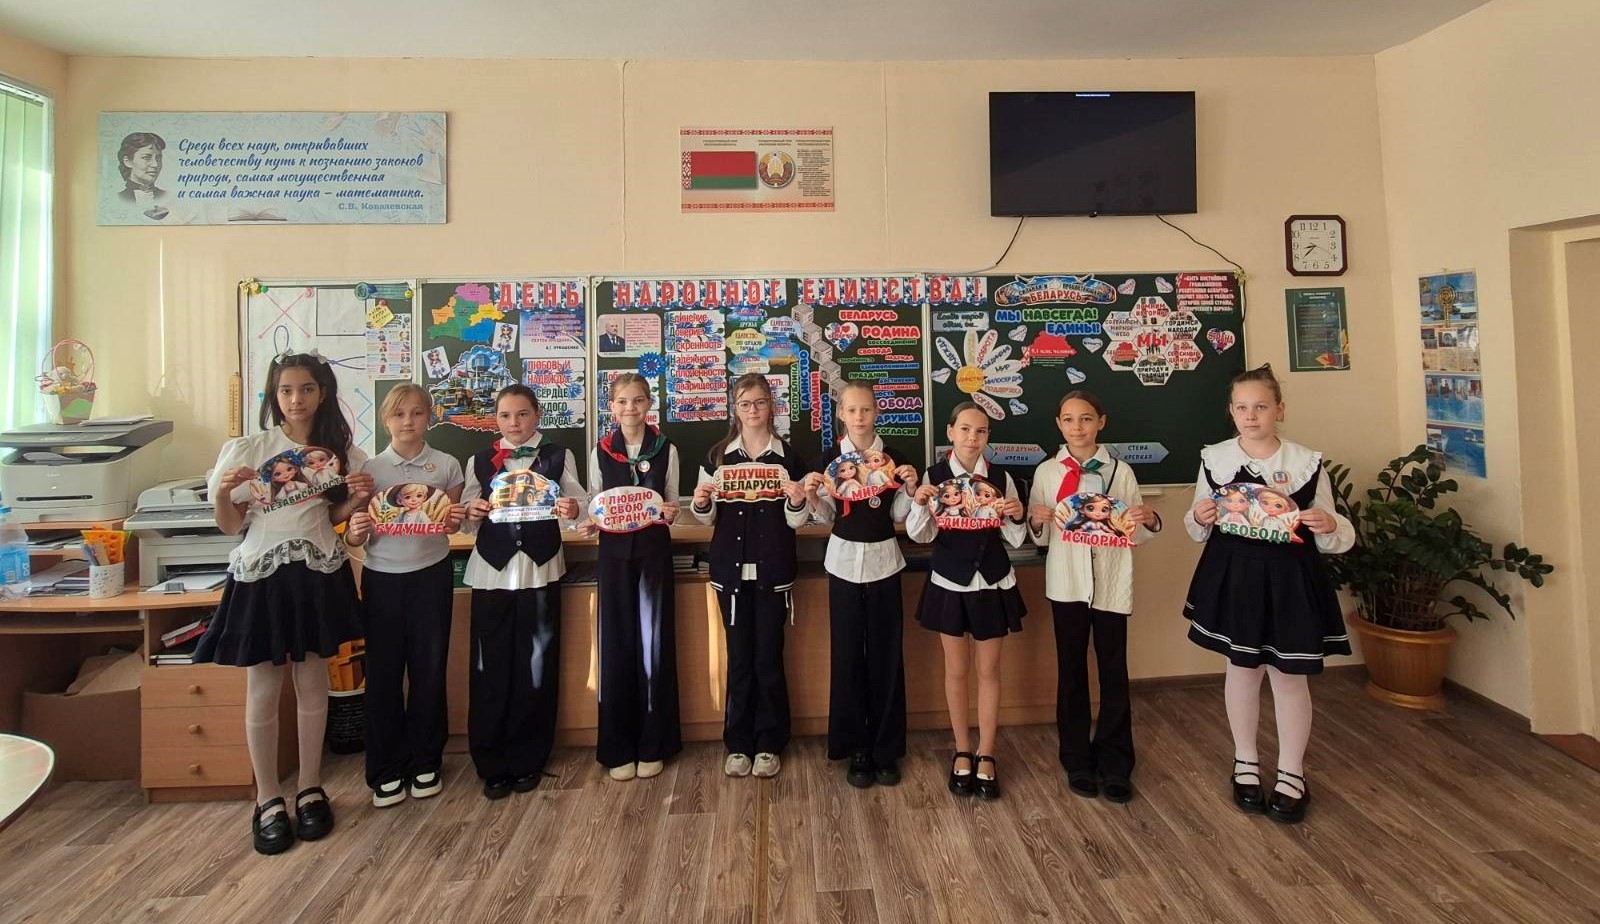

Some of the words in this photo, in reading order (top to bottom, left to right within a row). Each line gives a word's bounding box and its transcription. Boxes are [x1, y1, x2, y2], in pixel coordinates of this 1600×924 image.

[178, 138, 215, 156] Среди
[218, 138, 245, 151] всех
[247, 140, 280, 156] наук,
[283, 138, 369, 156] открывавших
[178, 154, 261, 171] человечеству
[265, 156, 296, 170] путь
[298, 156, 306, 167] к
[309, 156, 372, 167] познанию
[374, 154, 424, 171] законов
[177, 172, 232, 187] природы,
[235, 172, 273, 183] самая
[276, 172, 385, 187] могущественная
[177, 188, 187, 198] и
[188, 188, 226, 198] самая
[230, 186, 281, 198] важная
[284, 188, 320, 202] наука
[335, 187, 424, 199] математика.
[338, 203, 358, 211] С.В.
[361, 203, 424, 211] Ковалевская
[1300, 222, 1306, 231] 11
[1309, 222, 1319, 231] 12
[1322, 222, 1327, 231] 1
[1292, 230, 1300, 239] 10
[1329, 230, 1336, 239] 2
[1292, 242, 1299, 250] 9
[1330, 242, 1336, 250] 3
[1330, 254, 1338, 262] 4
[1302, 261, 1309, 269] 7
[1313, 260, 1320, 269] 6
[1323, 261, 1330, 270] 5
[498, 282, 581, 310] ДЕНЬ
[802, 277, 982, 305] ЕДИНСТВА!
[1031, 289, 1082, 302] БЕЛАРУСЬ
[839, 310, 897, 321] БЕЛАРУСЬ
[996, 310, 1020, 321] МЫ
[1023, 309, 1097, 321] НАВСЕГДА!
[862, 327, 920, 338] РОДИНА
[1047, 323, 1100, 335] ЕДИНЫ!
[1137, 334, 1167, 347] МЫ
[858, 347, 892, 355] СВОБОДА
[976, 332, 996, 363] ДОБРОТА
[527, 360, 562, 371] ЛЮБОВЬ
[564, 360, 571, 369] И
[800, 351, 810, 410] ЕДИНСТВО
[536, 387, 569, 399] СЕРДЦЕ
[791, 361, 799, 420] РЕСПУБЛИКА
[538, 402, 568, 412] ЖДОГО
[811, 372, 820, 430] ТРАДИЦИЯ
[973, 394, 1005, 418] СОГЛАСИЕ
[822, 394, 832, 448] РАТСТВО
[875, 413, 922, 425] ДРУЖБА
[1123, 453, 1153, 461] КРЕПКАЯ
[722, 468, 780, 481] БУДУЩЕЕ
[722, 480, 781, 491] БЕЛАРУСИ
[262, 475, 346, 514] НЕЗАВИСИМОСТЬ
[598, 497, 606, 505] Я
[608, 491, 653, 505] ЛЮБЛЮ
[852, 486, 879, 501] МИР
[610, 502, 643, 514] СВОЮ
[603, 511, 652, 526] СТРАНУ!
[937, 517, 1001, 529] ЕДИНСТВО
[375, 523, 445, 536] БУДУЩЕЕ
[1220, 522, 1290, 543] СВОБОДА
[1062, 531, 1129, 547] ИСТОРИЯ
